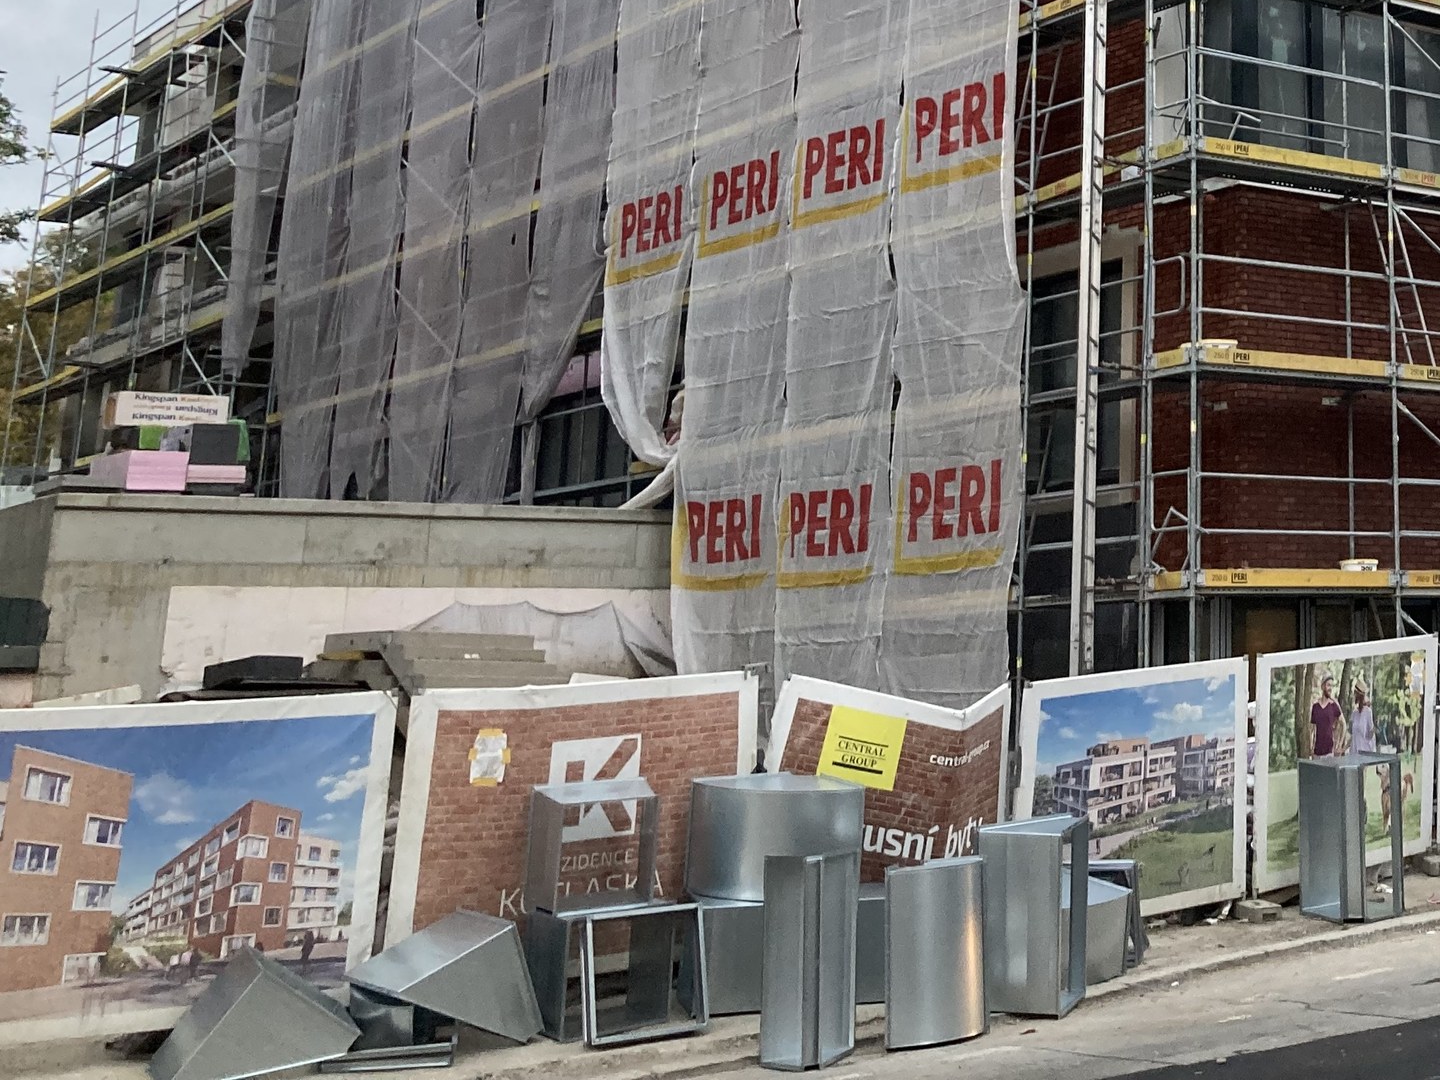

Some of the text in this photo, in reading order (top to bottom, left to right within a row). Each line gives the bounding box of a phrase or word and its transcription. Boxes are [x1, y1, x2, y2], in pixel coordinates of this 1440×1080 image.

[915, 72, 1006, 164] PERI
[803, 118, 885, 200] PERI
[709, 150, 780, 230] PERI
[620, 185, 683, 258] PERI
[132, 412, 176, 421] Kingspan
[135, 393, 178, 403] Kingspan
[175, 405, 218, 416] Kingspan
[789, 484, 873, 558] PERI
[907, 459, 1002, 543] PERI
[687, 494, 762, 565] PERI
[838, 740, 886, 758] CENTRAL
[841, 753, 878, 769] GROUP
[561, 848, 634, 872] ZIDENCE
[863, 824, 940, 861] usní
